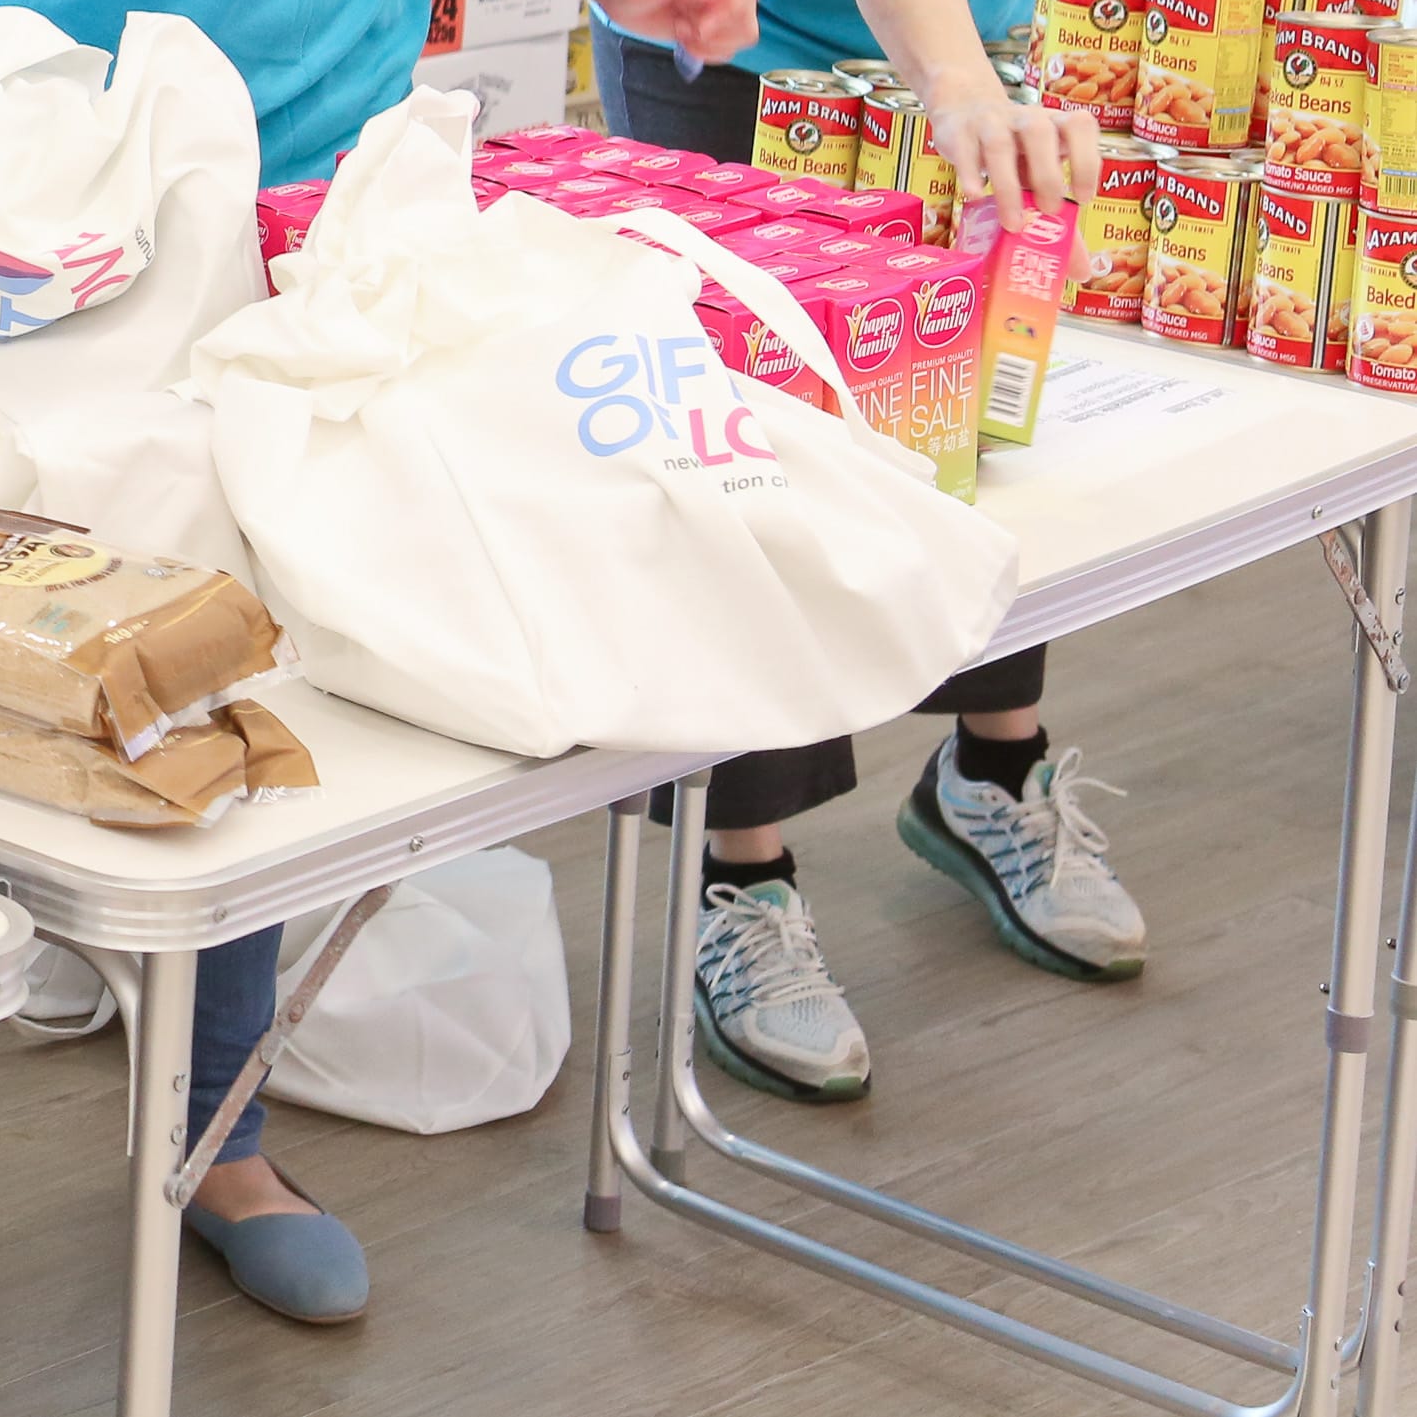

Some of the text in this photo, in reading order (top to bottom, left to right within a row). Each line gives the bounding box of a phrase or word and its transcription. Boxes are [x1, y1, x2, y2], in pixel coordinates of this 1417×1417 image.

[1058, 28, 1142, 52] Baked Bea
[1301, 29, 1363, 66] BRAND
[1153, 48, 1197, 73] Beans
[762, 97, 858, 130] AYAM BRAND
[1104, 104, 1134, 118] Sauc
[1299, 93, 1351, 115] Beans
[863, 111, 887, 143] AND
[1146, 119, 1178, 136] Sauce
[759, 148, 848, 175] Baked Beans
[1265, 163, 1332, 184] omato Sauce
[929, 179, 955, 195] Bak
[1103, 168, 1156, 191] AYAM
[1168, 175, 1220, 215] BRAND
[1261, 195, 1307, 235] BRAND
[1104, 223, 1151, 241] Baked
[1367, 229, 1417, 251] AYAM
[1162, 236, 1206, 261] Beans
[1256, 257, 1294, 282] Beans
[930, 288, 972, 313] happy
[1108, 295, 1142, 308] Tomat
[1367, 285, 1416, 310] Baked
[859, 311, 900, 336] happy
[921, 309, 969, 336] family
[1156, 311, 1187, 328] Sauce
[853, 333, 899, 360] family
[912, 347, 974, 370] PREMIUM QUALITY
[555, 334, 744, 404] GIF
[877, 371, 903, 387] QUALITY
[911, 358, 973, 405] FINE
[1370, 362, 1416, 380] Tomato
[910, 391, 972, 439] SALT
[722, 474, 764, 493] tion
